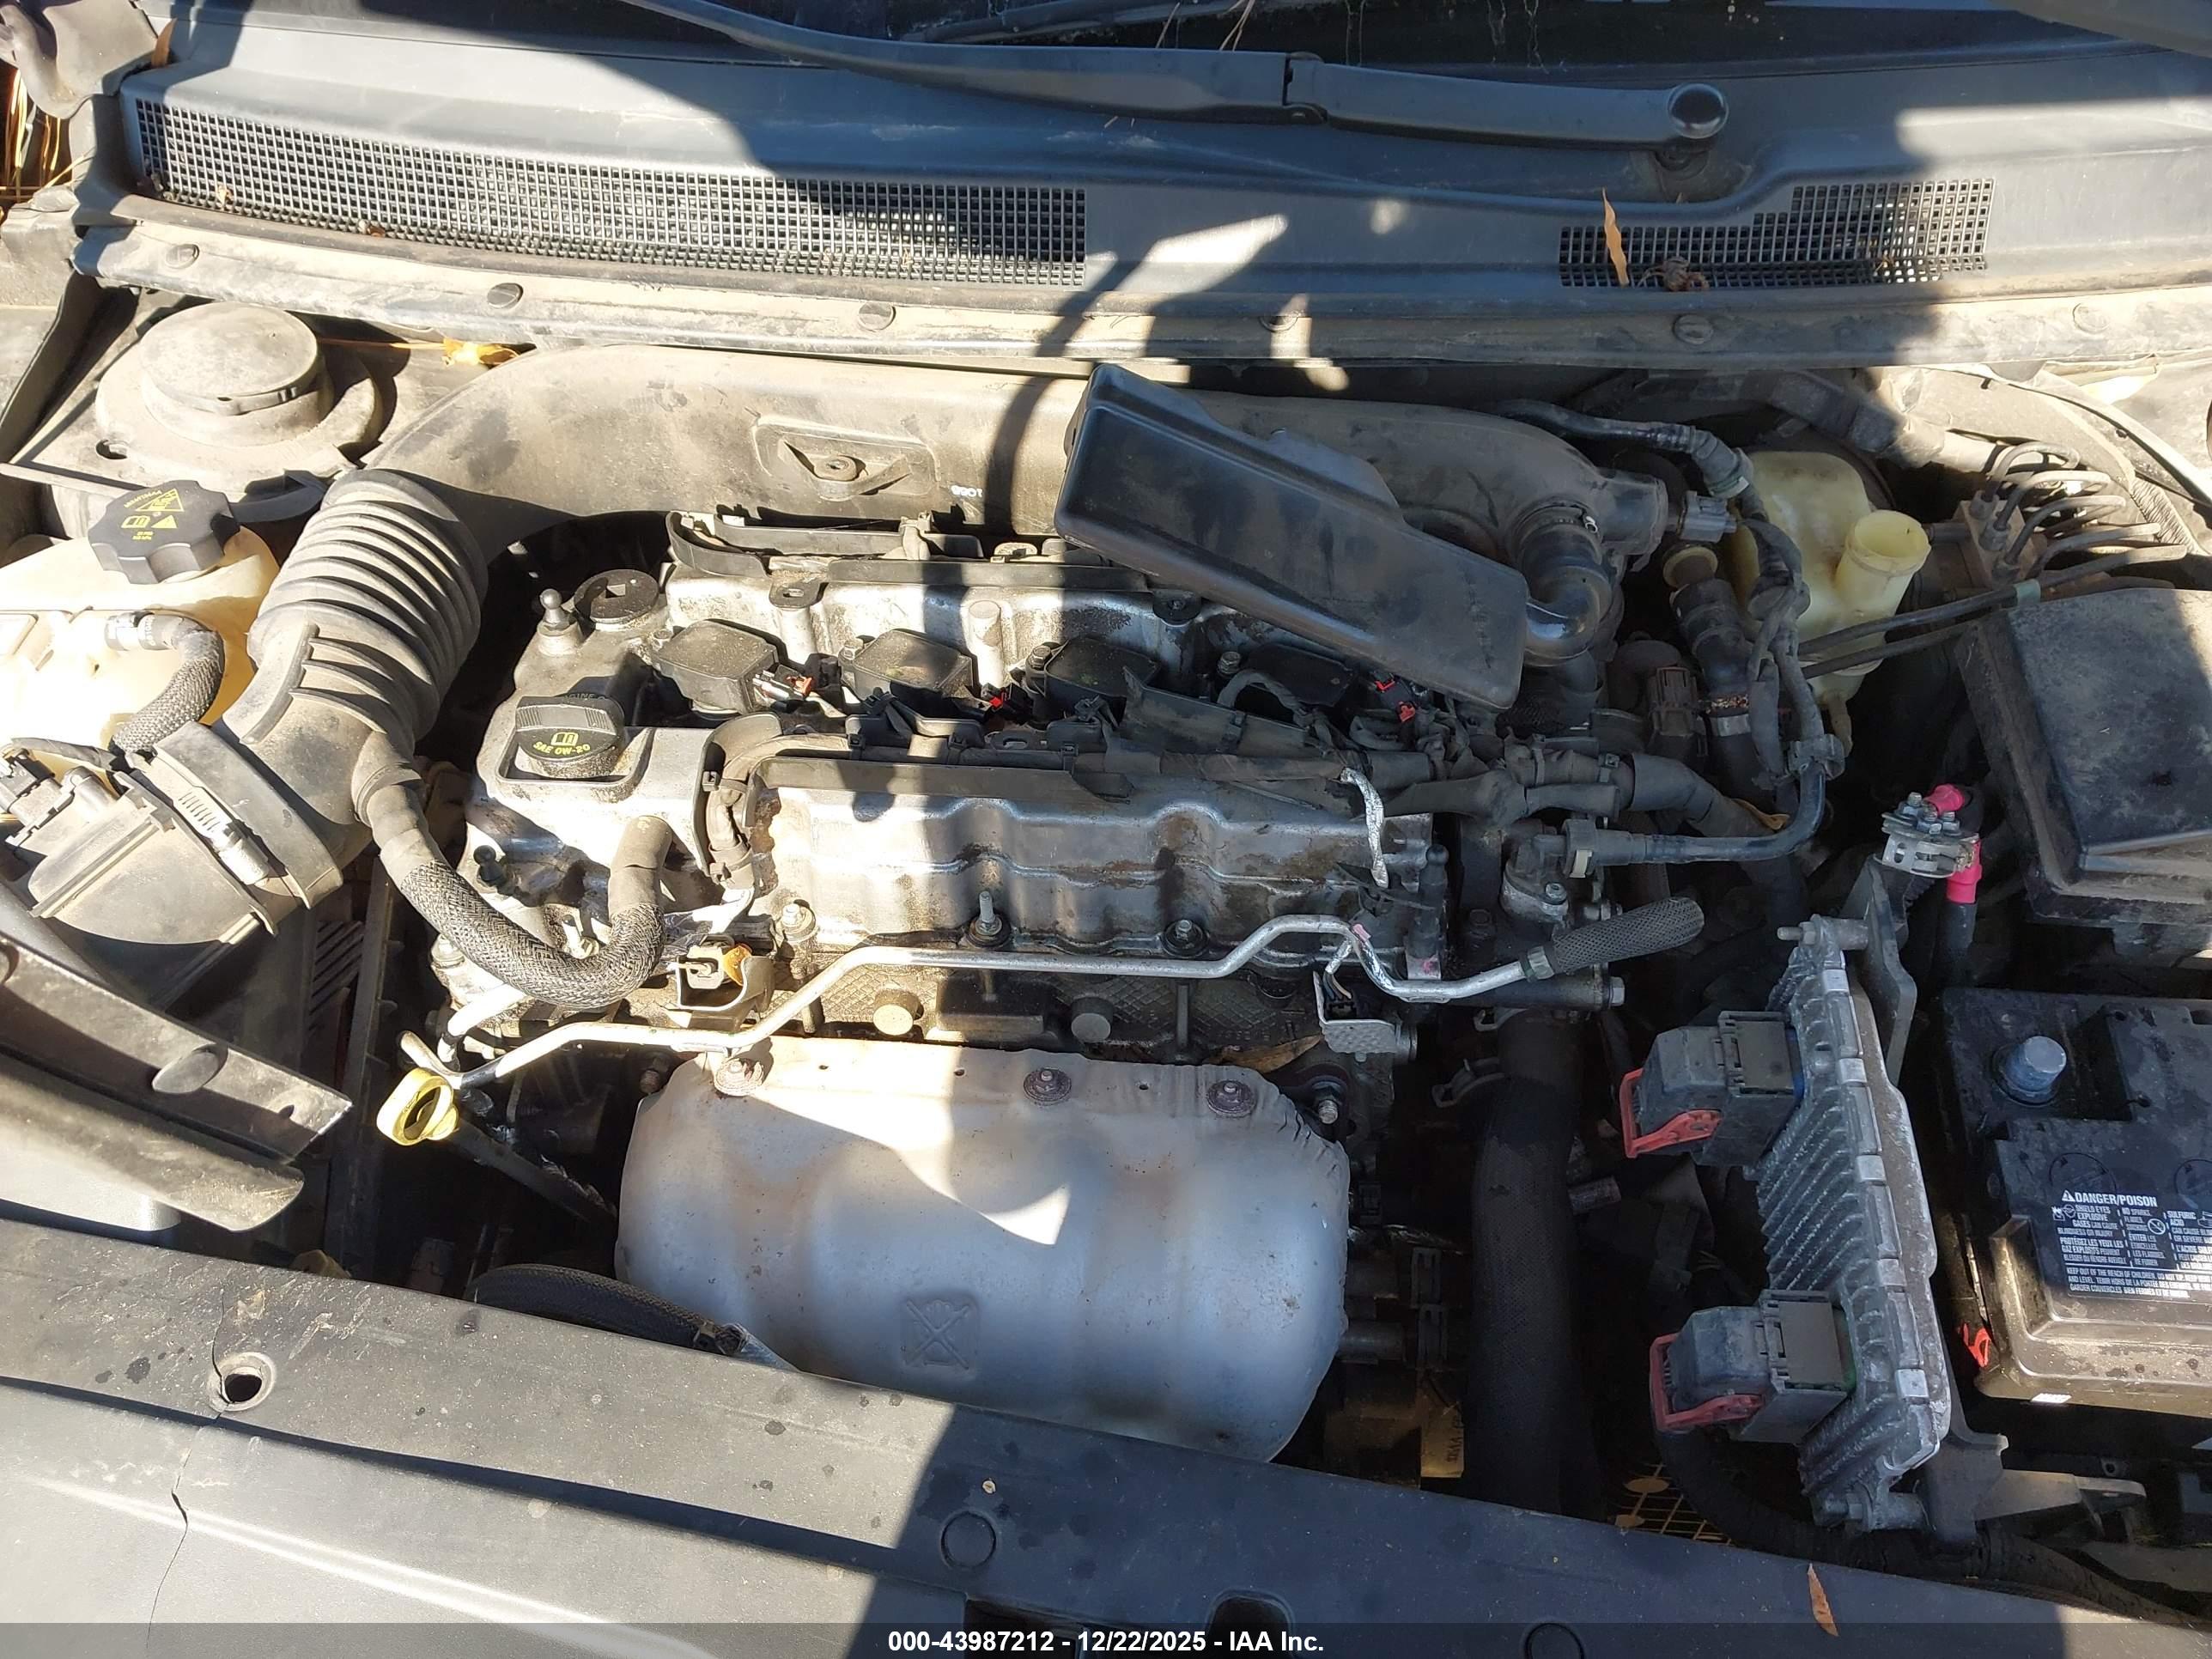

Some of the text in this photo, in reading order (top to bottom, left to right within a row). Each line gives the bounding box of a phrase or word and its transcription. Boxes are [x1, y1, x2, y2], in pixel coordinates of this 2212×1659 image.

[532, 741, 591, 756] SAE 0W-20
[2075, 1193, 2157, 1206] DANGER/POISON
